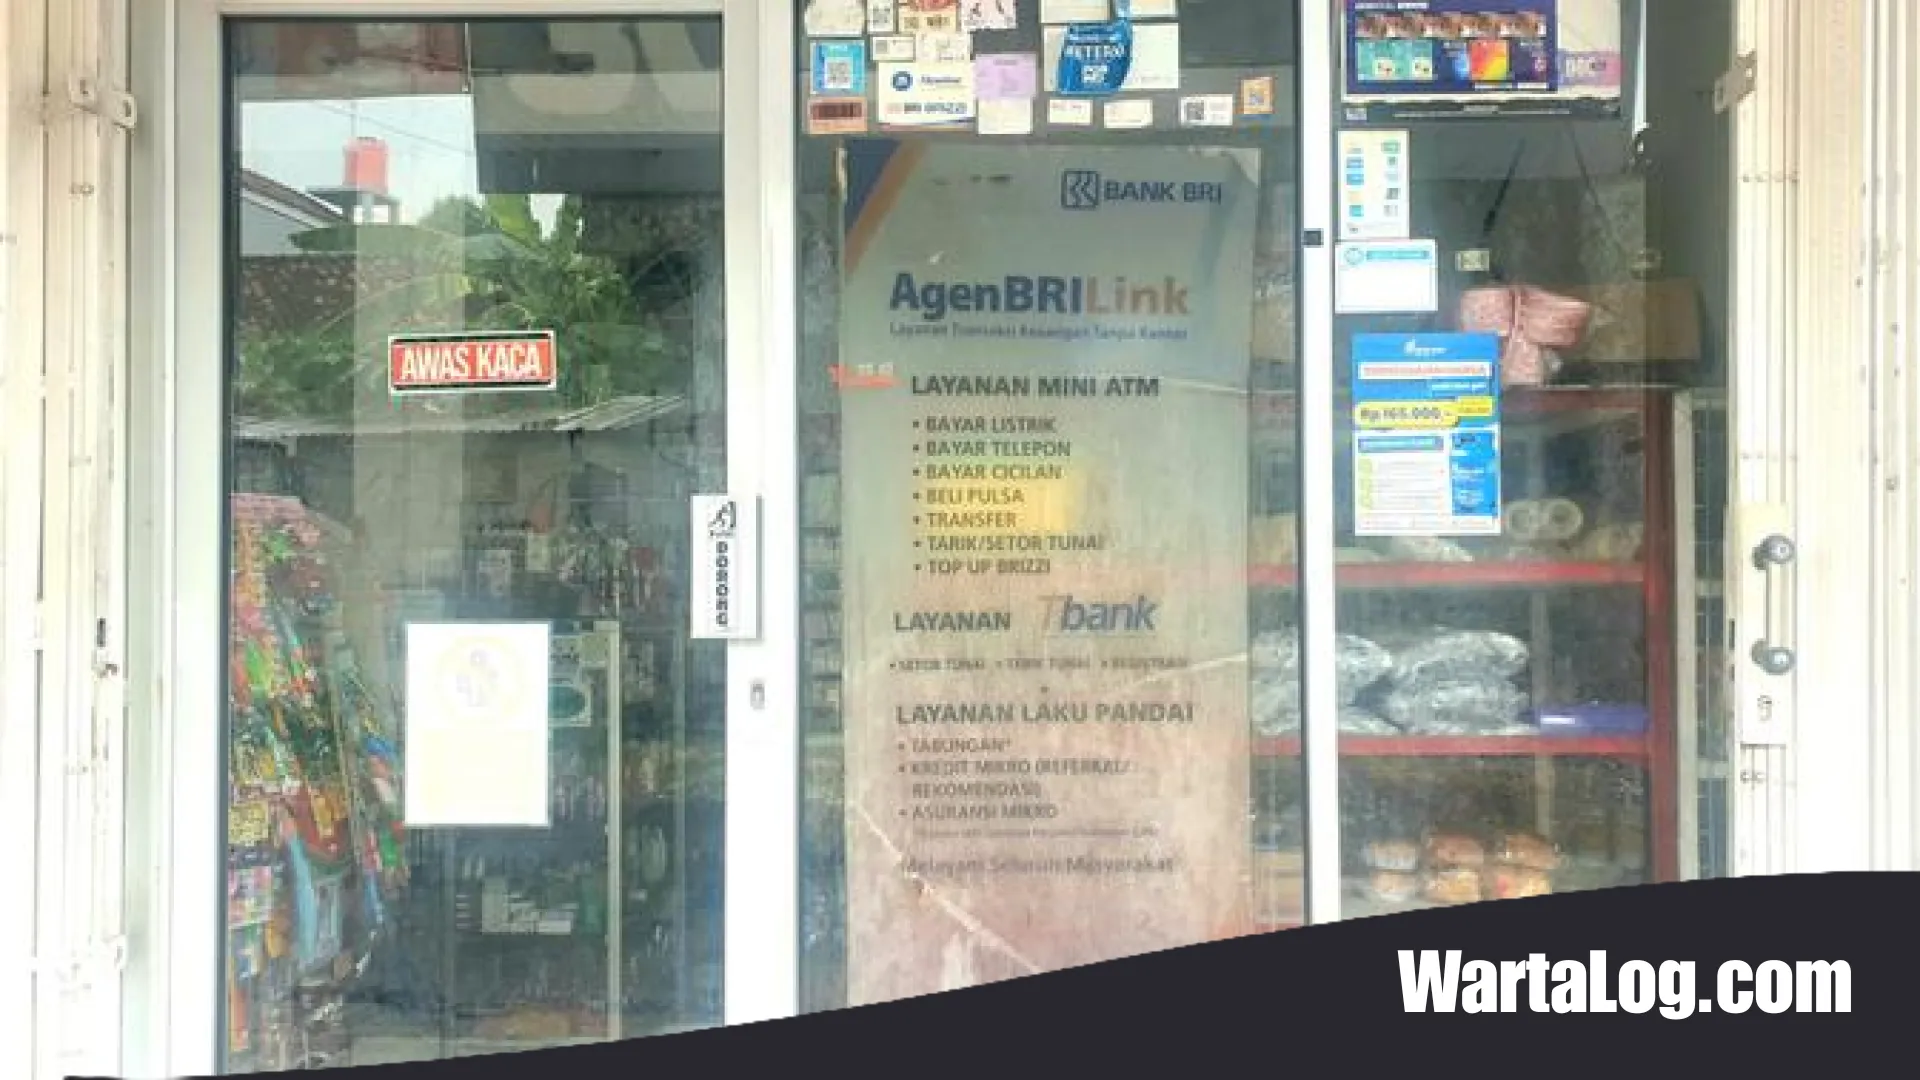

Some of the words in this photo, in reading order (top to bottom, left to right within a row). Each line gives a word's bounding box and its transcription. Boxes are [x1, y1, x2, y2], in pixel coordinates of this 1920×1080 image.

[1104, 180, 1176, 202] BANK
[1183, 181, 1222, 204] BRI
[889, 272, 1190, 321] AgenBRILink
[890, 321, 948, 340] Layanan
[401, 345, 469, 381] AWAS
[475, 342, 542, 378] KACA
[911, 374, 1030, 398] LAYANAN
[1037, 374, 1097, 397] MINI
[1103, 374, 1161, 397] ATM
[926, 416, 986, 433] BAYAR
[991, 416, 1056, 433] LISTRIK
[926, 441, 986, 457] BAYAR
[991, 441, 1071, 457] TELEPON
[926, 464, 986, 480] BAYAR
[991, 464, 1063, 480] CICILAN
[926, 488, 963, 504] BELI
[968, 487, 1025, 504] PULSA
[926, 512, 1018, 528] TRANSFER
[927, 535, 1042, 551] TARIK/SETOR
[1049, 535, 1105, 551] TUNAI
[928, 558, 961, 574] TOP
[966, 558, 992, 574] UP
[997, 558, 1051, 574] BRIZZI
[894, 611, 1011, 632] LAYANAN
[895, 702, 1013, 724] LAYANAN
[1021, 701, 1088, 722] LAKU
[1095, 701, 1194, 722] PANDAI
[911, 758, 968, 775] KREDIT
[975, 758, 1031, 775] MIKRO
